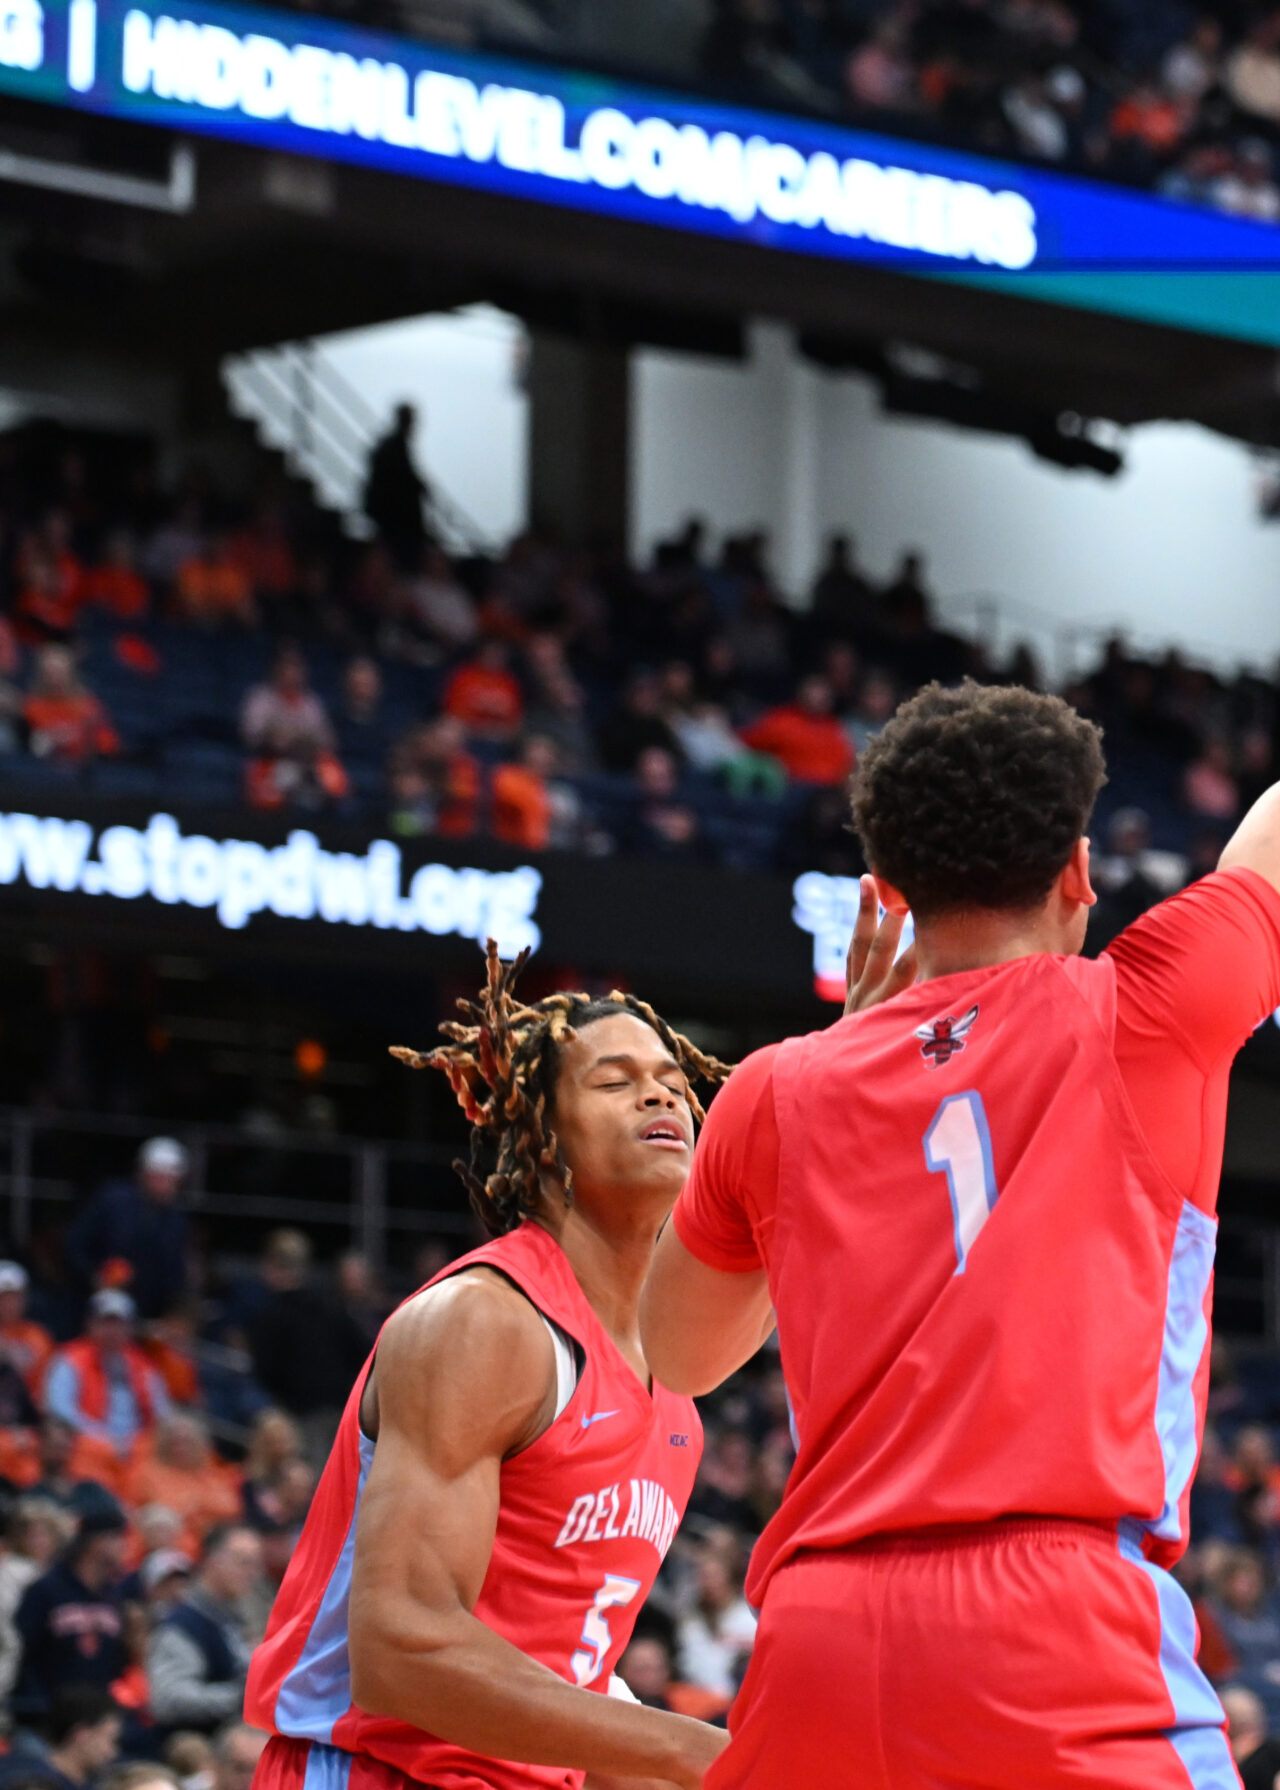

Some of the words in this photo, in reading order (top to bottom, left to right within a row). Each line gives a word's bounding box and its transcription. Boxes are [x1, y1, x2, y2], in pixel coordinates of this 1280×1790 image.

[122, 8, 1037, 270] HIDDENLEVEL.COM/CAREERS
[921, 1088, 999, 1276] 1
[569, 1572, 642, 1688] 5
